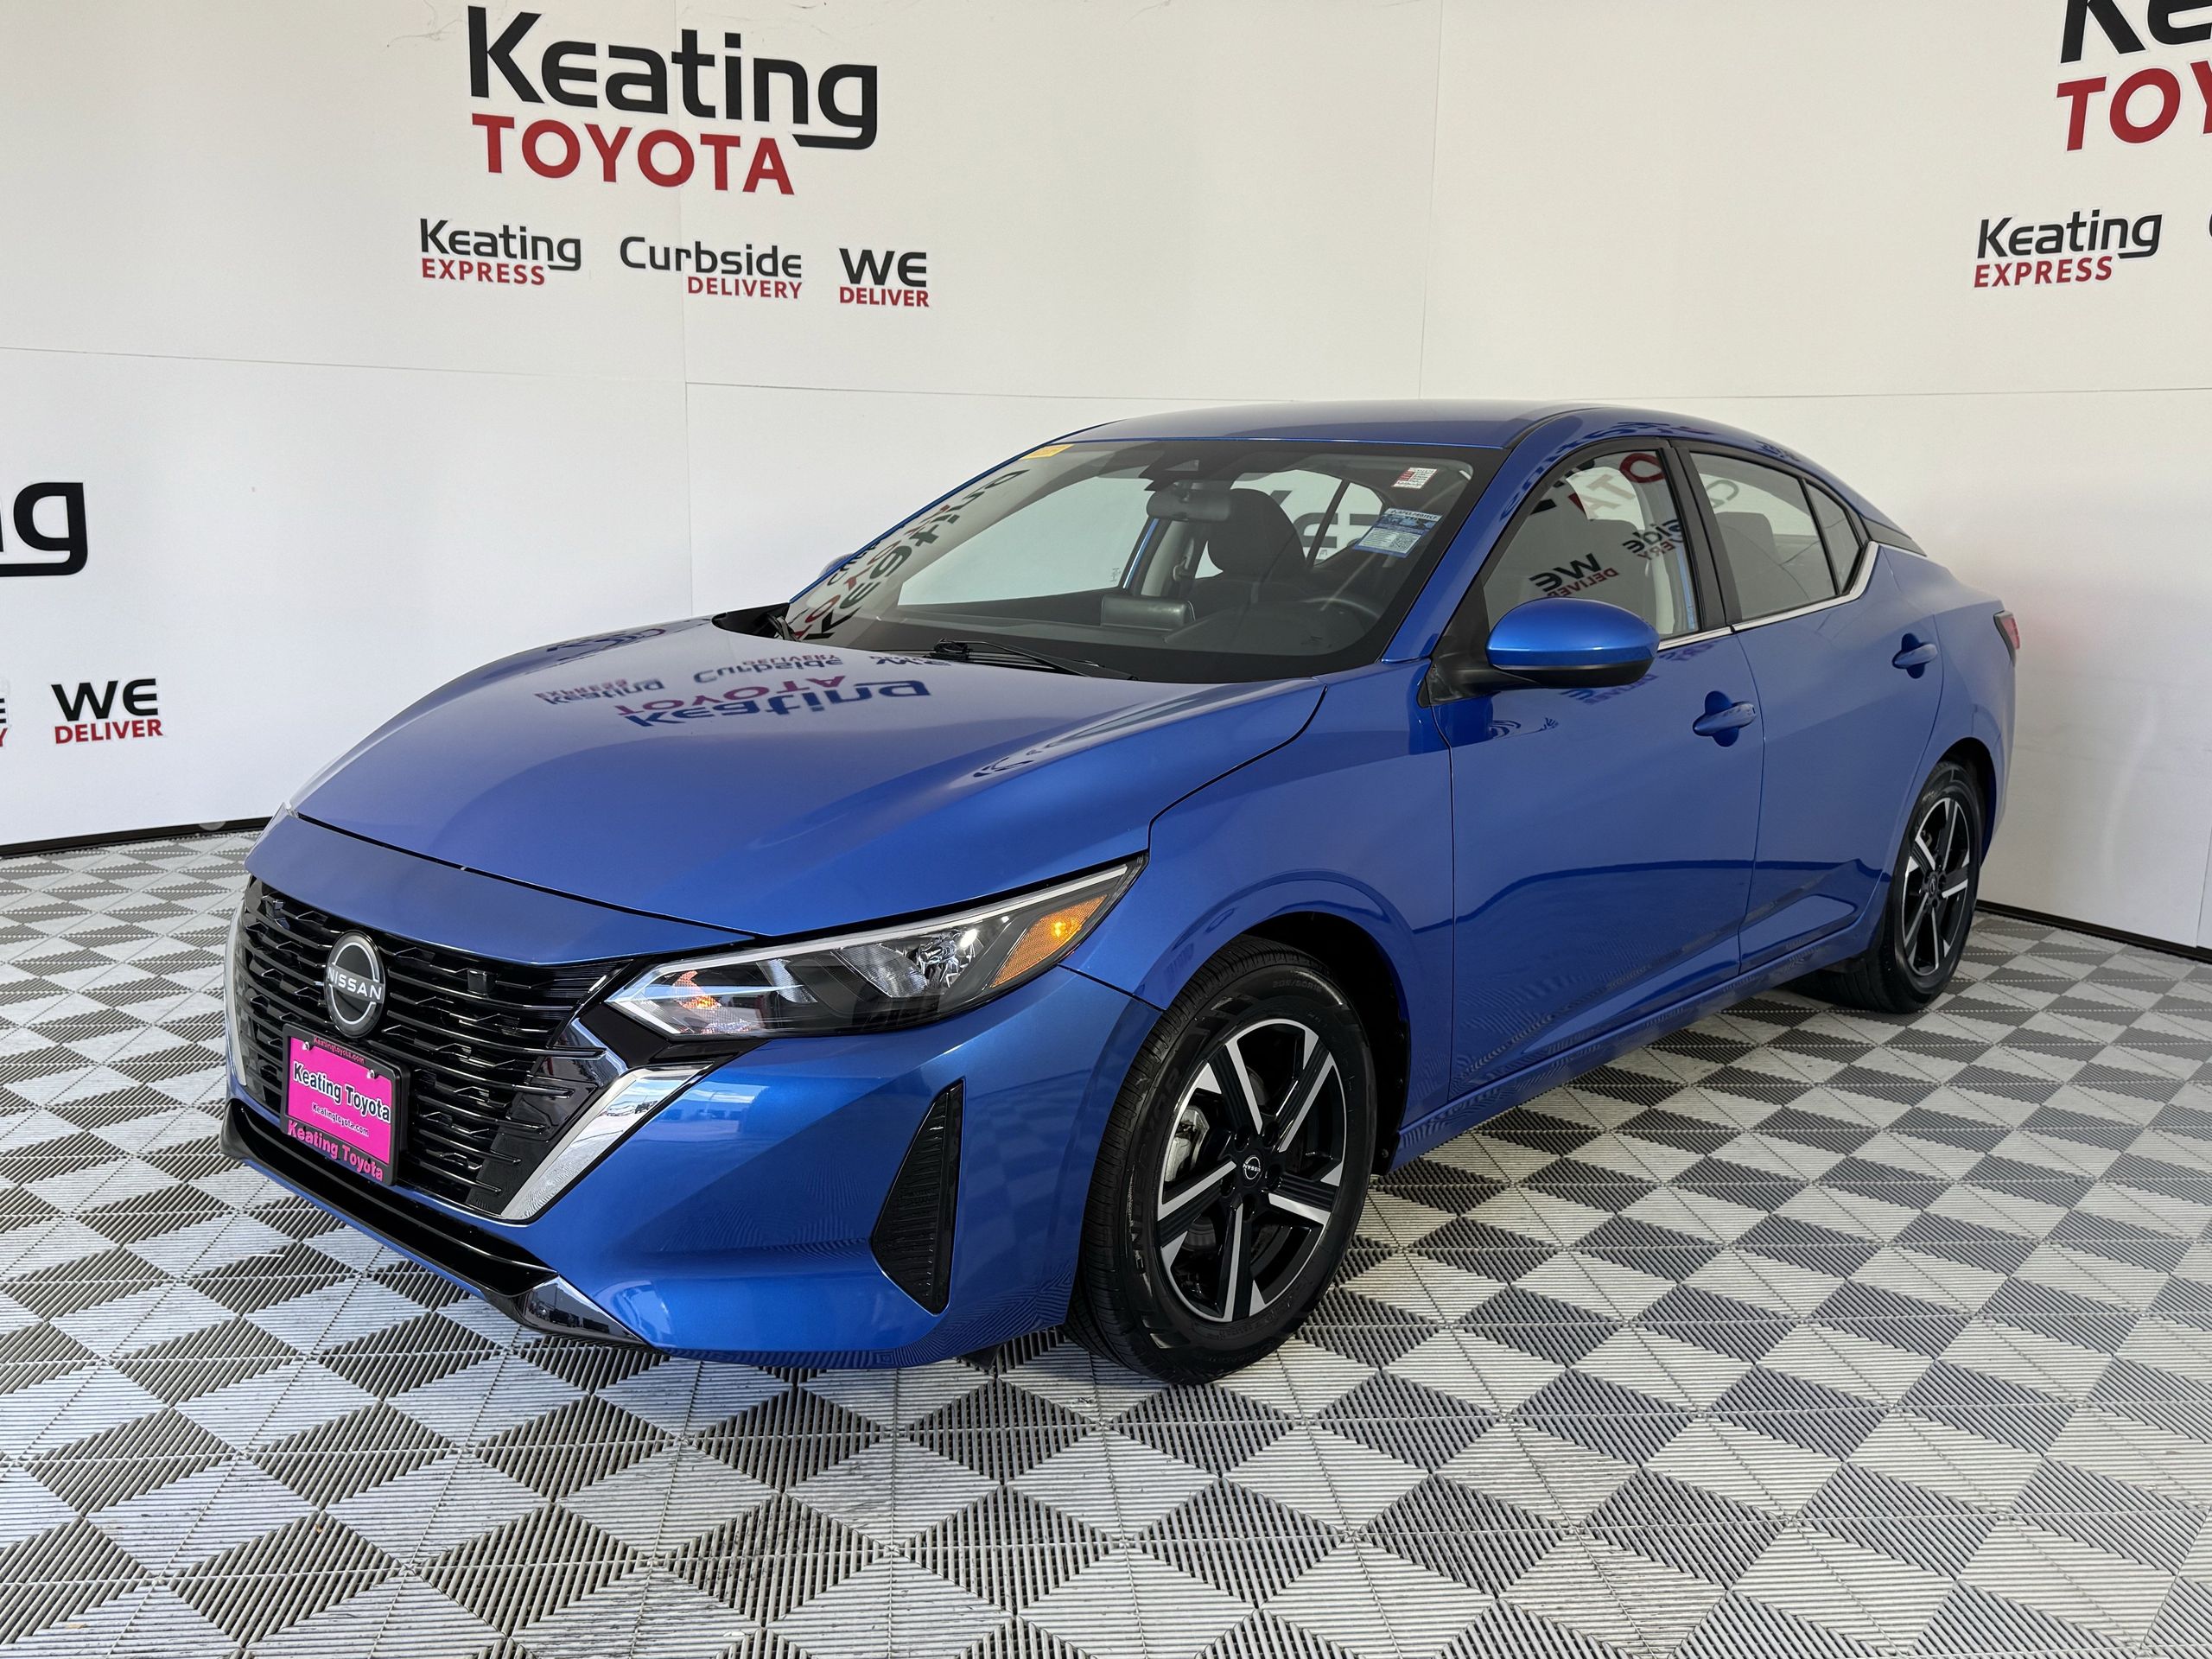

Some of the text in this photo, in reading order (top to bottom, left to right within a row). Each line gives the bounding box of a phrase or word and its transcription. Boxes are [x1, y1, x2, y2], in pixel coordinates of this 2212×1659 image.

[467, 5, 878, 150] Keating
[472, 112, 795, 195] TOYOTA
[420, 218, 582, 271] Keating
[1977, 208, 2163, 259] Keating
[422, 257, 545, 286] EXPRESS
[620, 236, 802, 279] Curbside
[840, 248, 927, 288] WE
[1974, 256, 2113, 288] EXPRESS
[688, 276, 803, 300] DELIVERY
[840, 286, 930, 308] DELIVER
[50, 677, 159, 721] WE
[54, 718, 163, 744] DELIVER
[327, 966, 382, 1000] NISSAN
[293, 1062, 391, 1122] Keating Toyota
[312, 1103, 370, 1136] Keatingtoyota.com
[287, 1119, 384, 1182] Keating Toyota
